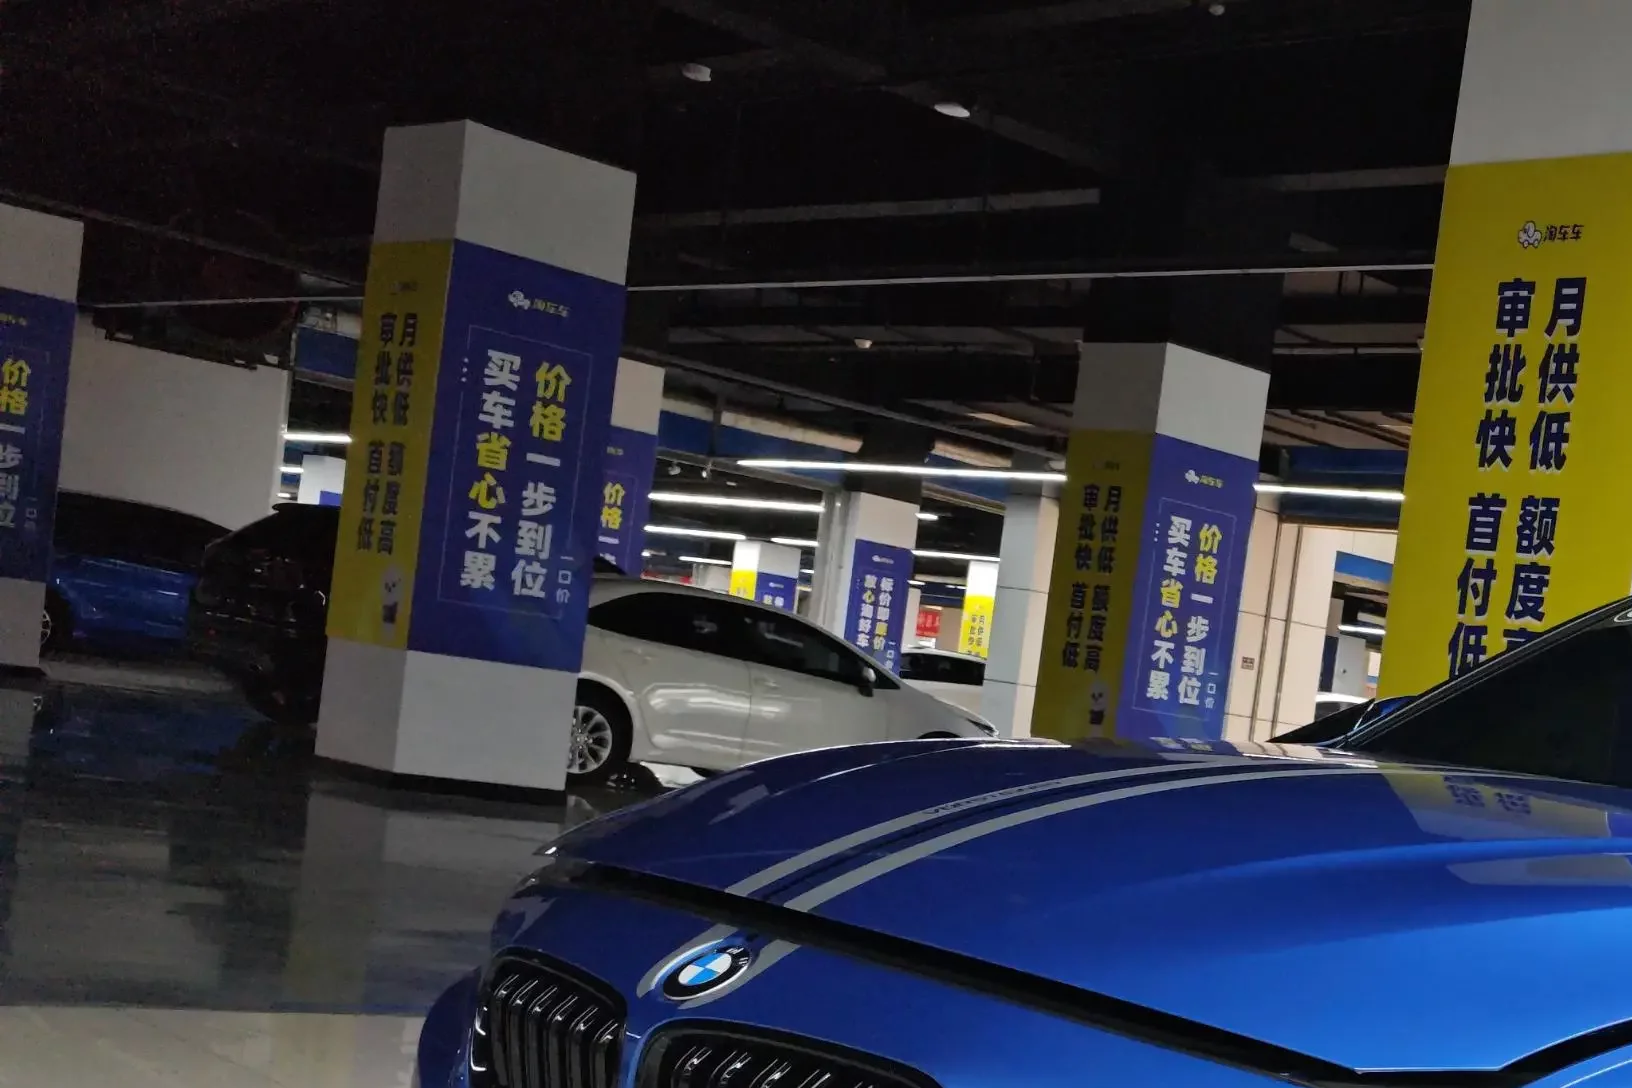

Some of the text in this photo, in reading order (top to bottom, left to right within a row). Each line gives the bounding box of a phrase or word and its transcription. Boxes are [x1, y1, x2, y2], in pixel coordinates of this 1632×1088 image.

[1543, 224, 1585, 242] 淘车车
[1528, 276, 1588, 472] 月供低
[460, 349, 522, 592] 买车省心不累
[511, 361, 573, 598] 价格一步到位
[1447, 278, 1537, 681] 审批快 首付低
[556, 555, 574, 604] 一口价
[1146, 515, 1193, 701] 买车省心不累
[1178, 523, 1223, 706] 价格一步到位
